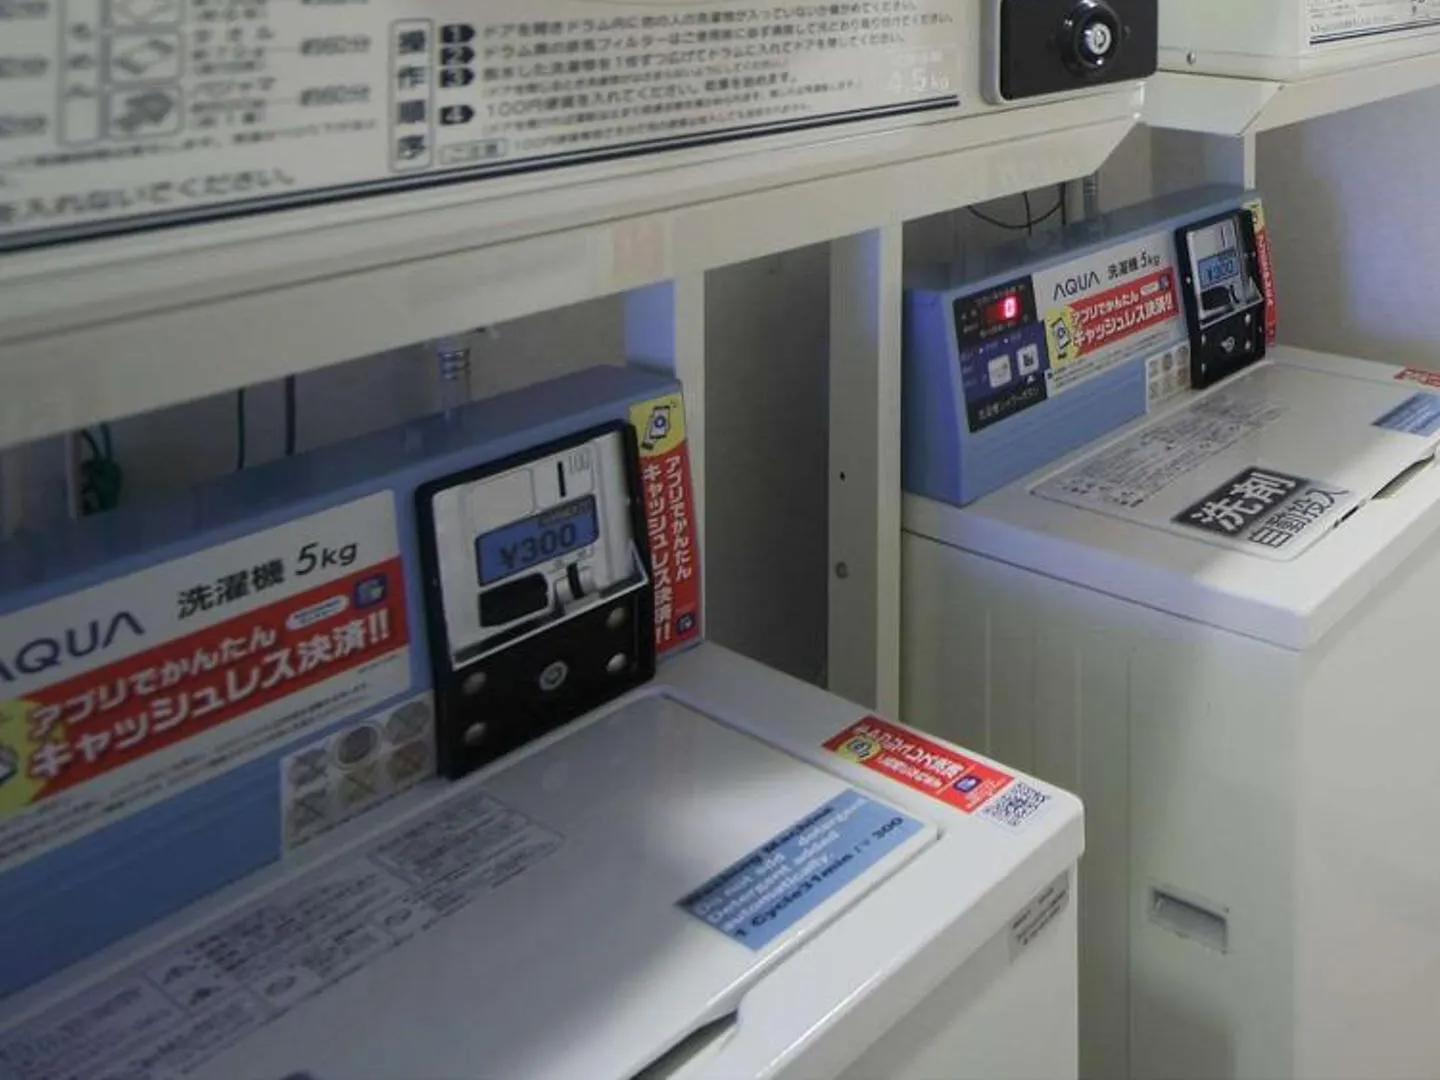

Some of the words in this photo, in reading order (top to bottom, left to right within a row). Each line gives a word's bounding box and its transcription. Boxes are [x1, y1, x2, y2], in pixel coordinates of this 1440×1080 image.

[1053, 270, 1100, 301] AQUA
[1190, 471, 1297, 532] 洗剤
[1248, 487, 1350, 549] 自動投入
[500, 523, 577, 571] ¥300
[176, 557, 286, 620] 洗濯機
[294, 541, 358, 577] 5kg
[28, 623, 277, 739] アプリでかんたん
[29, 609, 391, 779] キャッシュレス決済!!
